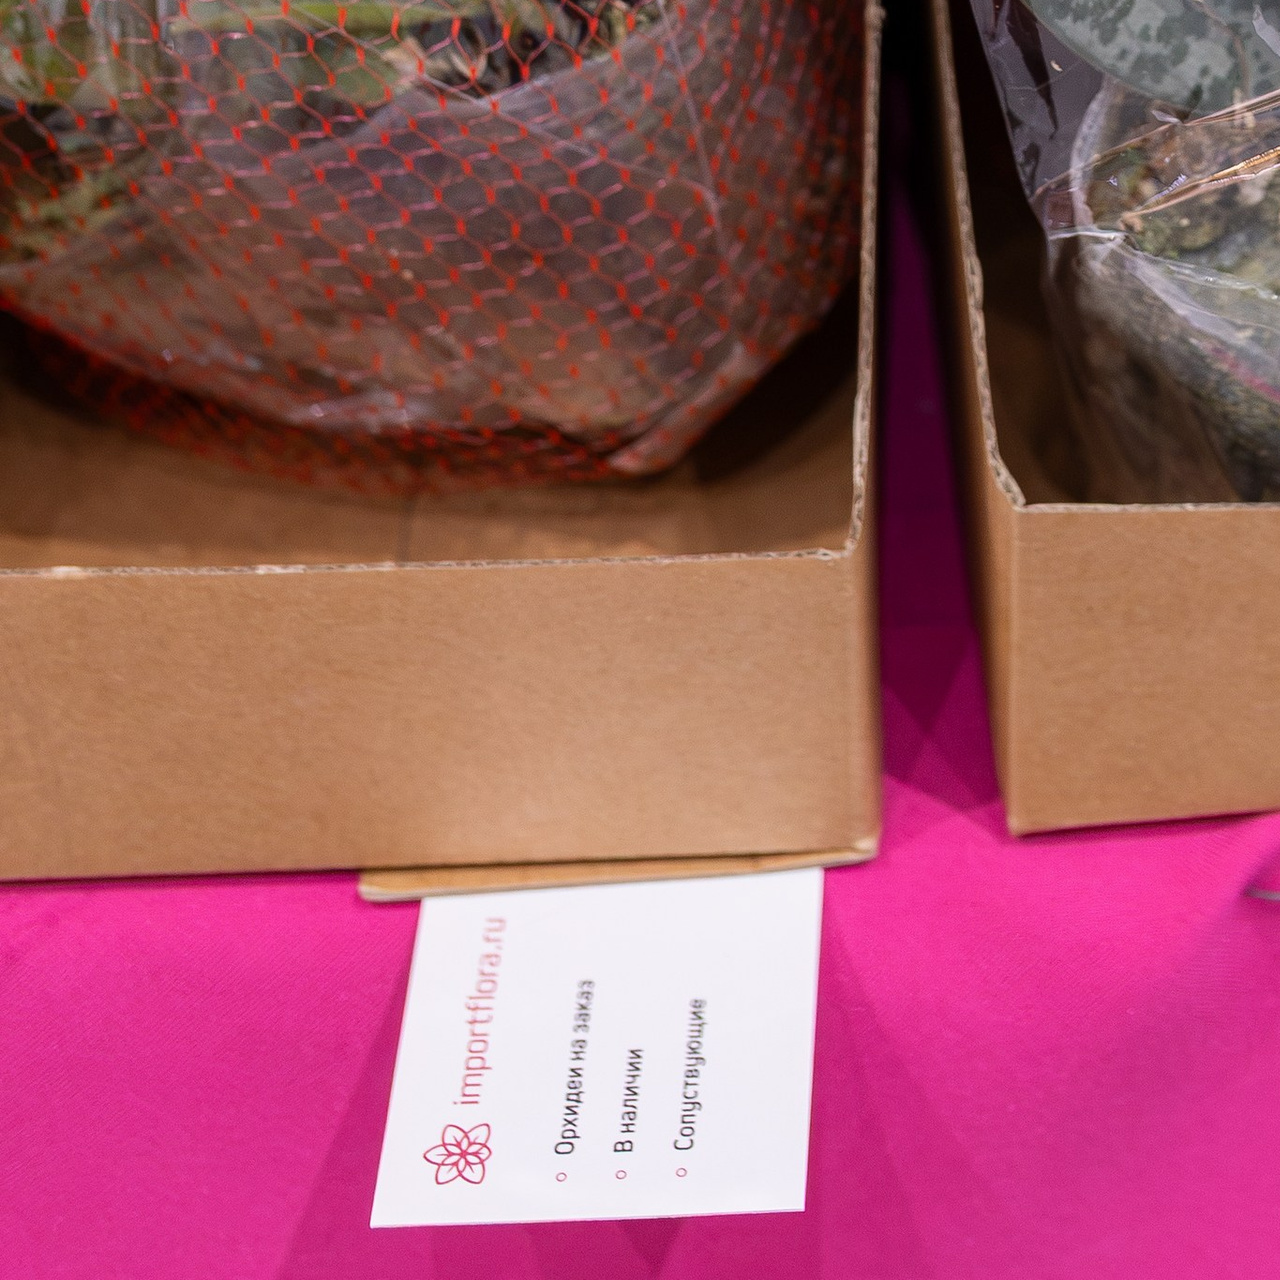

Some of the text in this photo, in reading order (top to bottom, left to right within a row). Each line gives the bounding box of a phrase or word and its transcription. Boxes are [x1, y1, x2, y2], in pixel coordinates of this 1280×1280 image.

[453, 916, 507, 1107] importflora.ru
[554, 979, 596, 1156] Орхидеи на заказ
[673, 997, 708, 1152] Сопуствующие
[613, 1047, 645, 1154] В наличии
